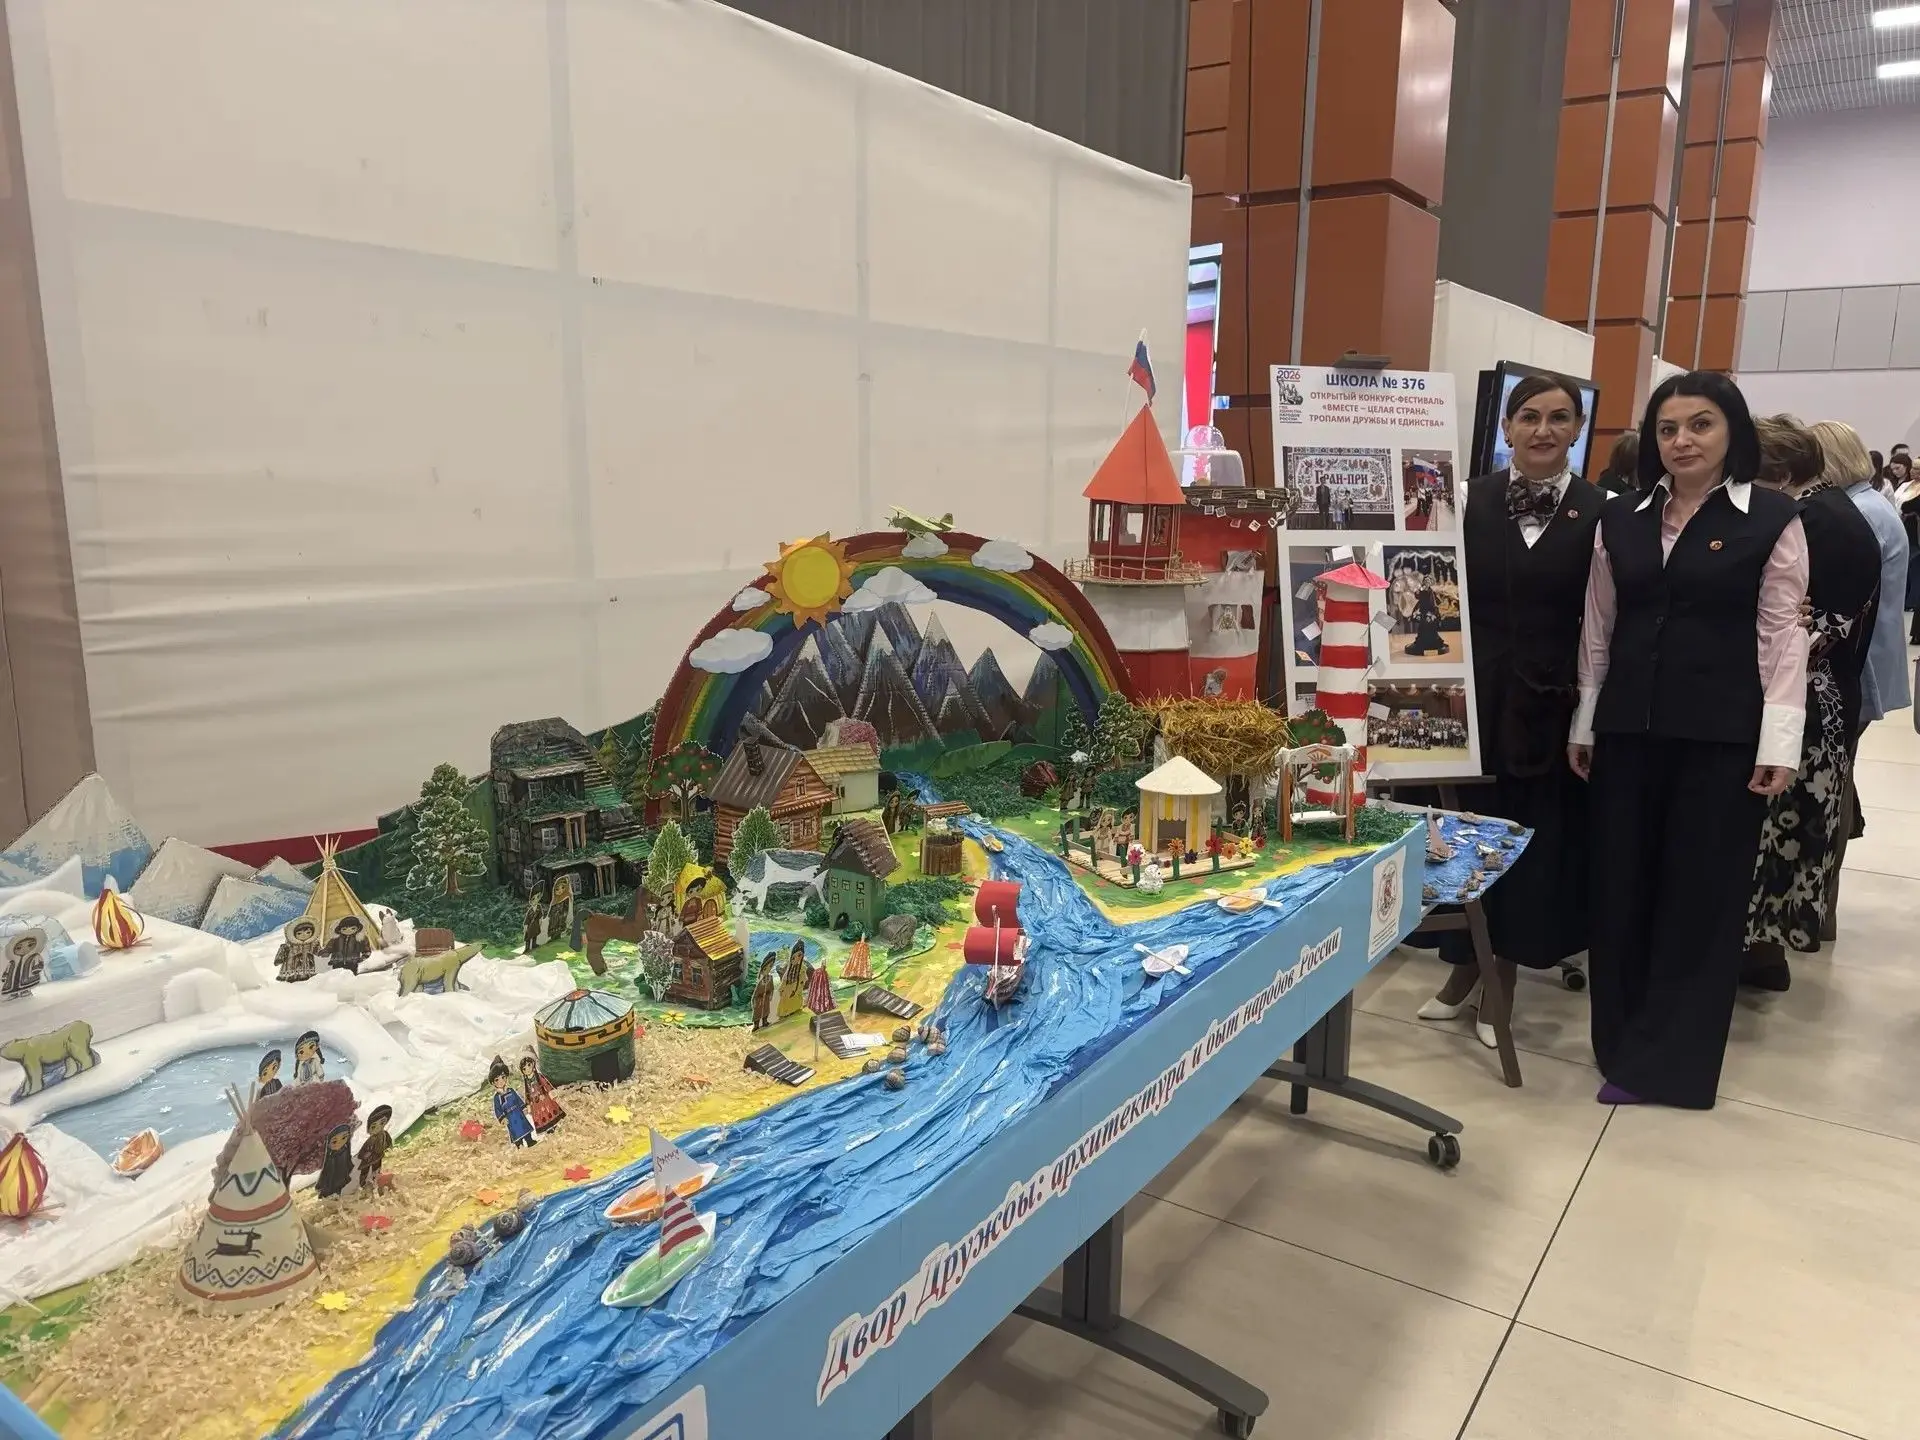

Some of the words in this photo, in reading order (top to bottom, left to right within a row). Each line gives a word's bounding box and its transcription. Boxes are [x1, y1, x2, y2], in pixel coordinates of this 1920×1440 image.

[1278, 370, 1300, 380] 2026
[1326, 374, 1378, 388] ШКОЛА
[1382, 376, 1398, 389] №
[1401, 378, 1425, 390] 376
[1310, 391, 1357, 400] ОТКРЫТЫЙ
[1358, 394, 1444, 405] КОНКУРС-ФЕСТИВАЛЬ
[1322, 404, 1359, 412] «ВМЕСТЕ
[1367, 405, 1394, 414] ЦЕЛАЯ
[1396, 406, 1429, 416] СТРАНА:
[1309, 414, 1351, 423] ТРОПАМИ
[1352, 416, 1388, 425] ДРУЖБЫ
[1390, 417, 1396, 425] И
[1399, 418, 1444, 427] ЕДИНСТВА»
[820, 1291, 907, 1402] Двор
[914, 1174, 1047, 1321] Дружбы:
[1051, 1058, 1186, 1192] архитектура
[1192, 1043, 1202, 1068] и
[1206, 1013, 1239, 1055] быт
[1243, 970, 1294, 1025] народов
[1300, 932, 1339, 977] России
